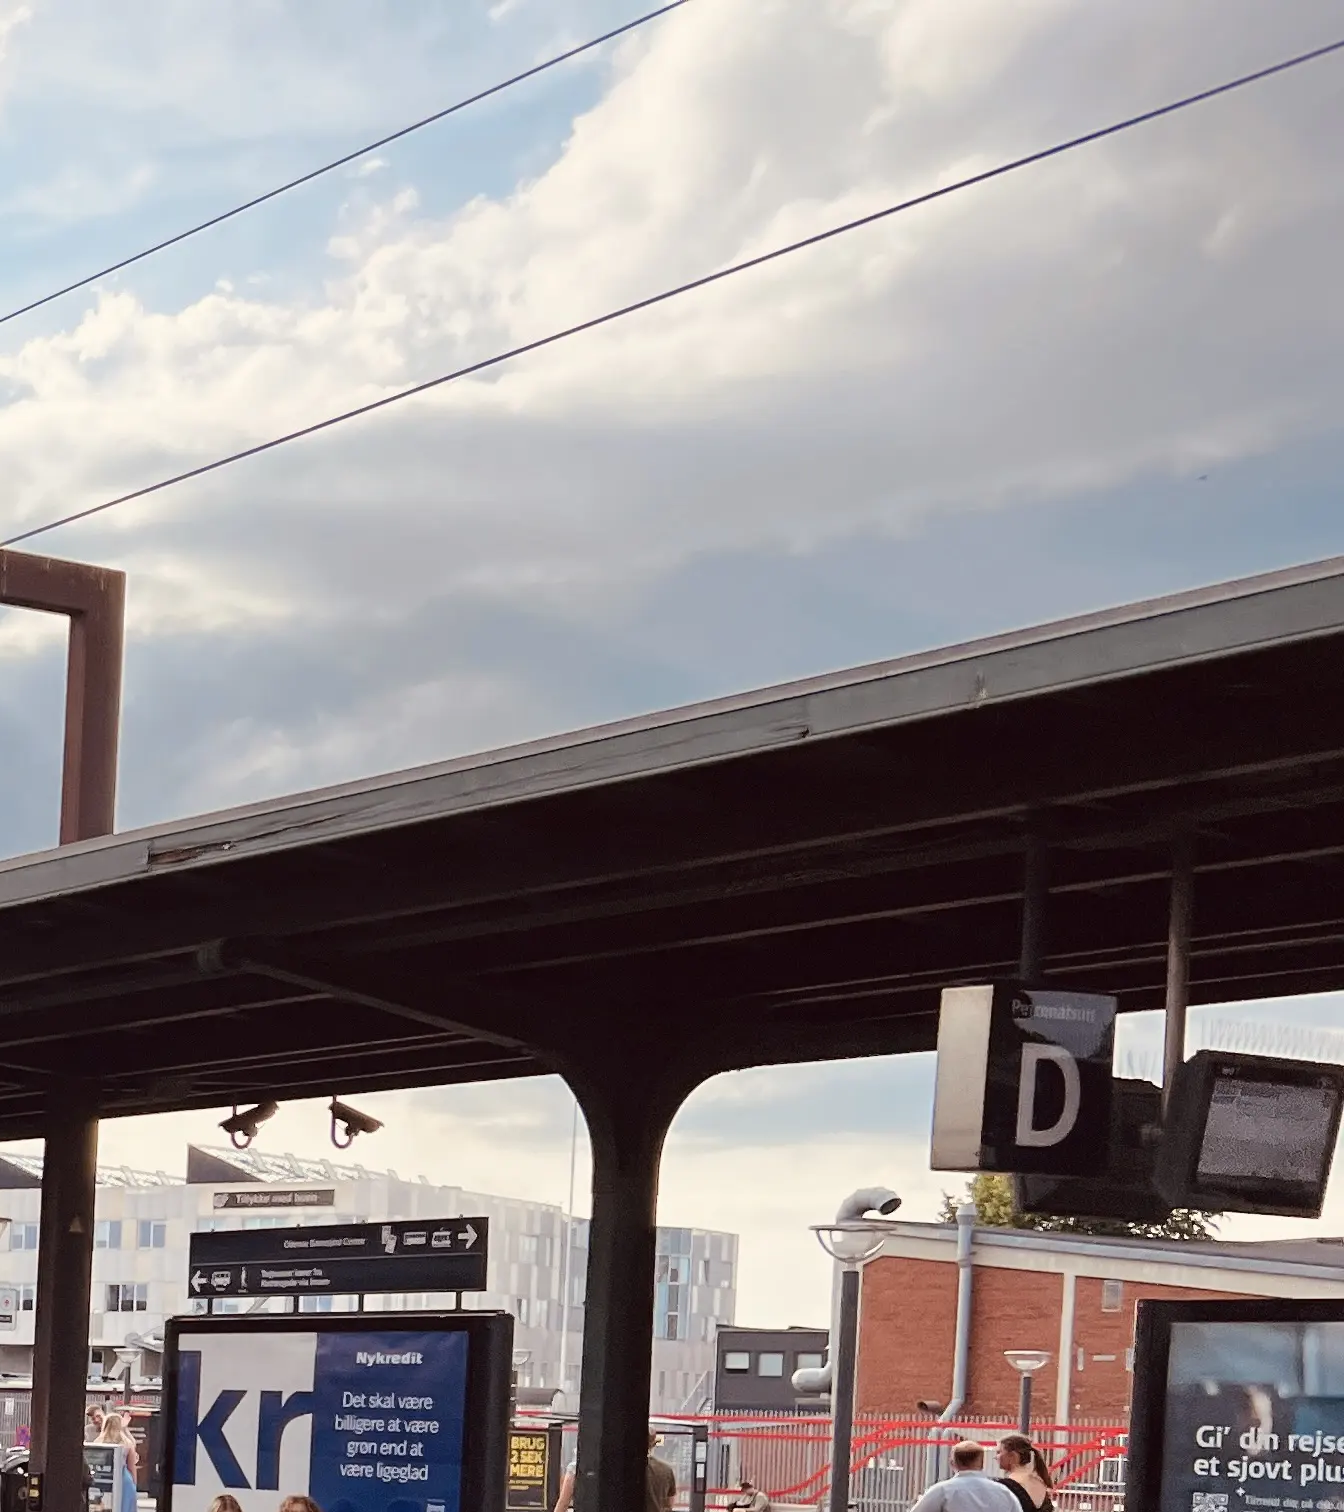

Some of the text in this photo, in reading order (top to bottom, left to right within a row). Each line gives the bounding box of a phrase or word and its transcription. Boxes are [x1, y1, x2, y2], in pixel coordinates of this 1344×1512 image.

[1015, 1042, 1081, 1148] D
[355, 1351, 424, 1367] Nykredit
[342, 1391, 433, 1410] Det skal være
[173, 1350, 313, 1491] kr
[334, 1413, 440, 1435] billigere at være
[379, 1440, 408, 1456] end
[409, 1441, 424, 1457] at
[511, 1436, 545, 1450] BRUG
[1238, 1426, 1280, 1451] din
[510, 1450, 519, 1463] 2
[339, 1461, 429, 1483] være ligeglad
[510, 1464, 544, 1477] MERE
[1193, 1455, 1344, 1487] et sjovt plu
